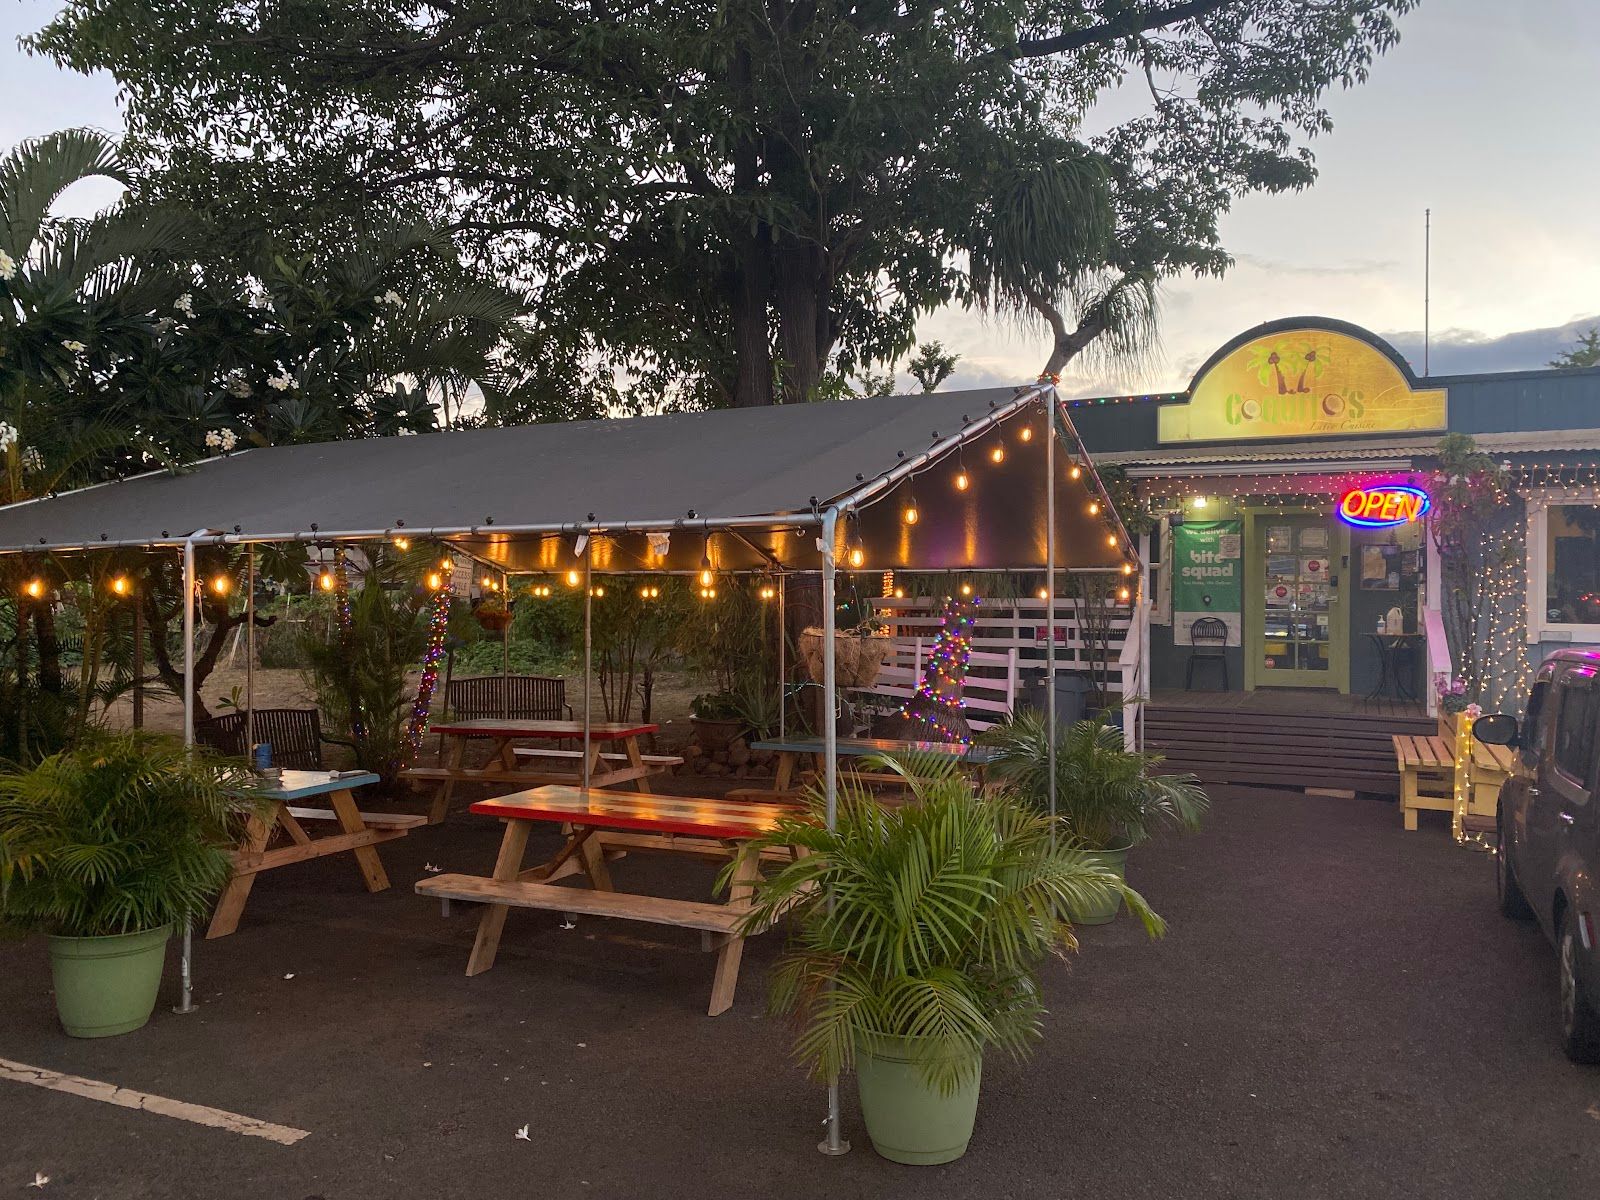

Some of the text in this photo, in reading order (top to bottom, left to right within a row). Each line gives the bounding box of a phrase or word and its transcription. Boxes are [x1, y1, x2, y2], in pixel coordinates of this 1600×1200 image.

[1340, 419, 1376, 430] Cuisine
[1343, 490, 1422, 522] OPEN
[1181, 562, 1233, 580] squad
